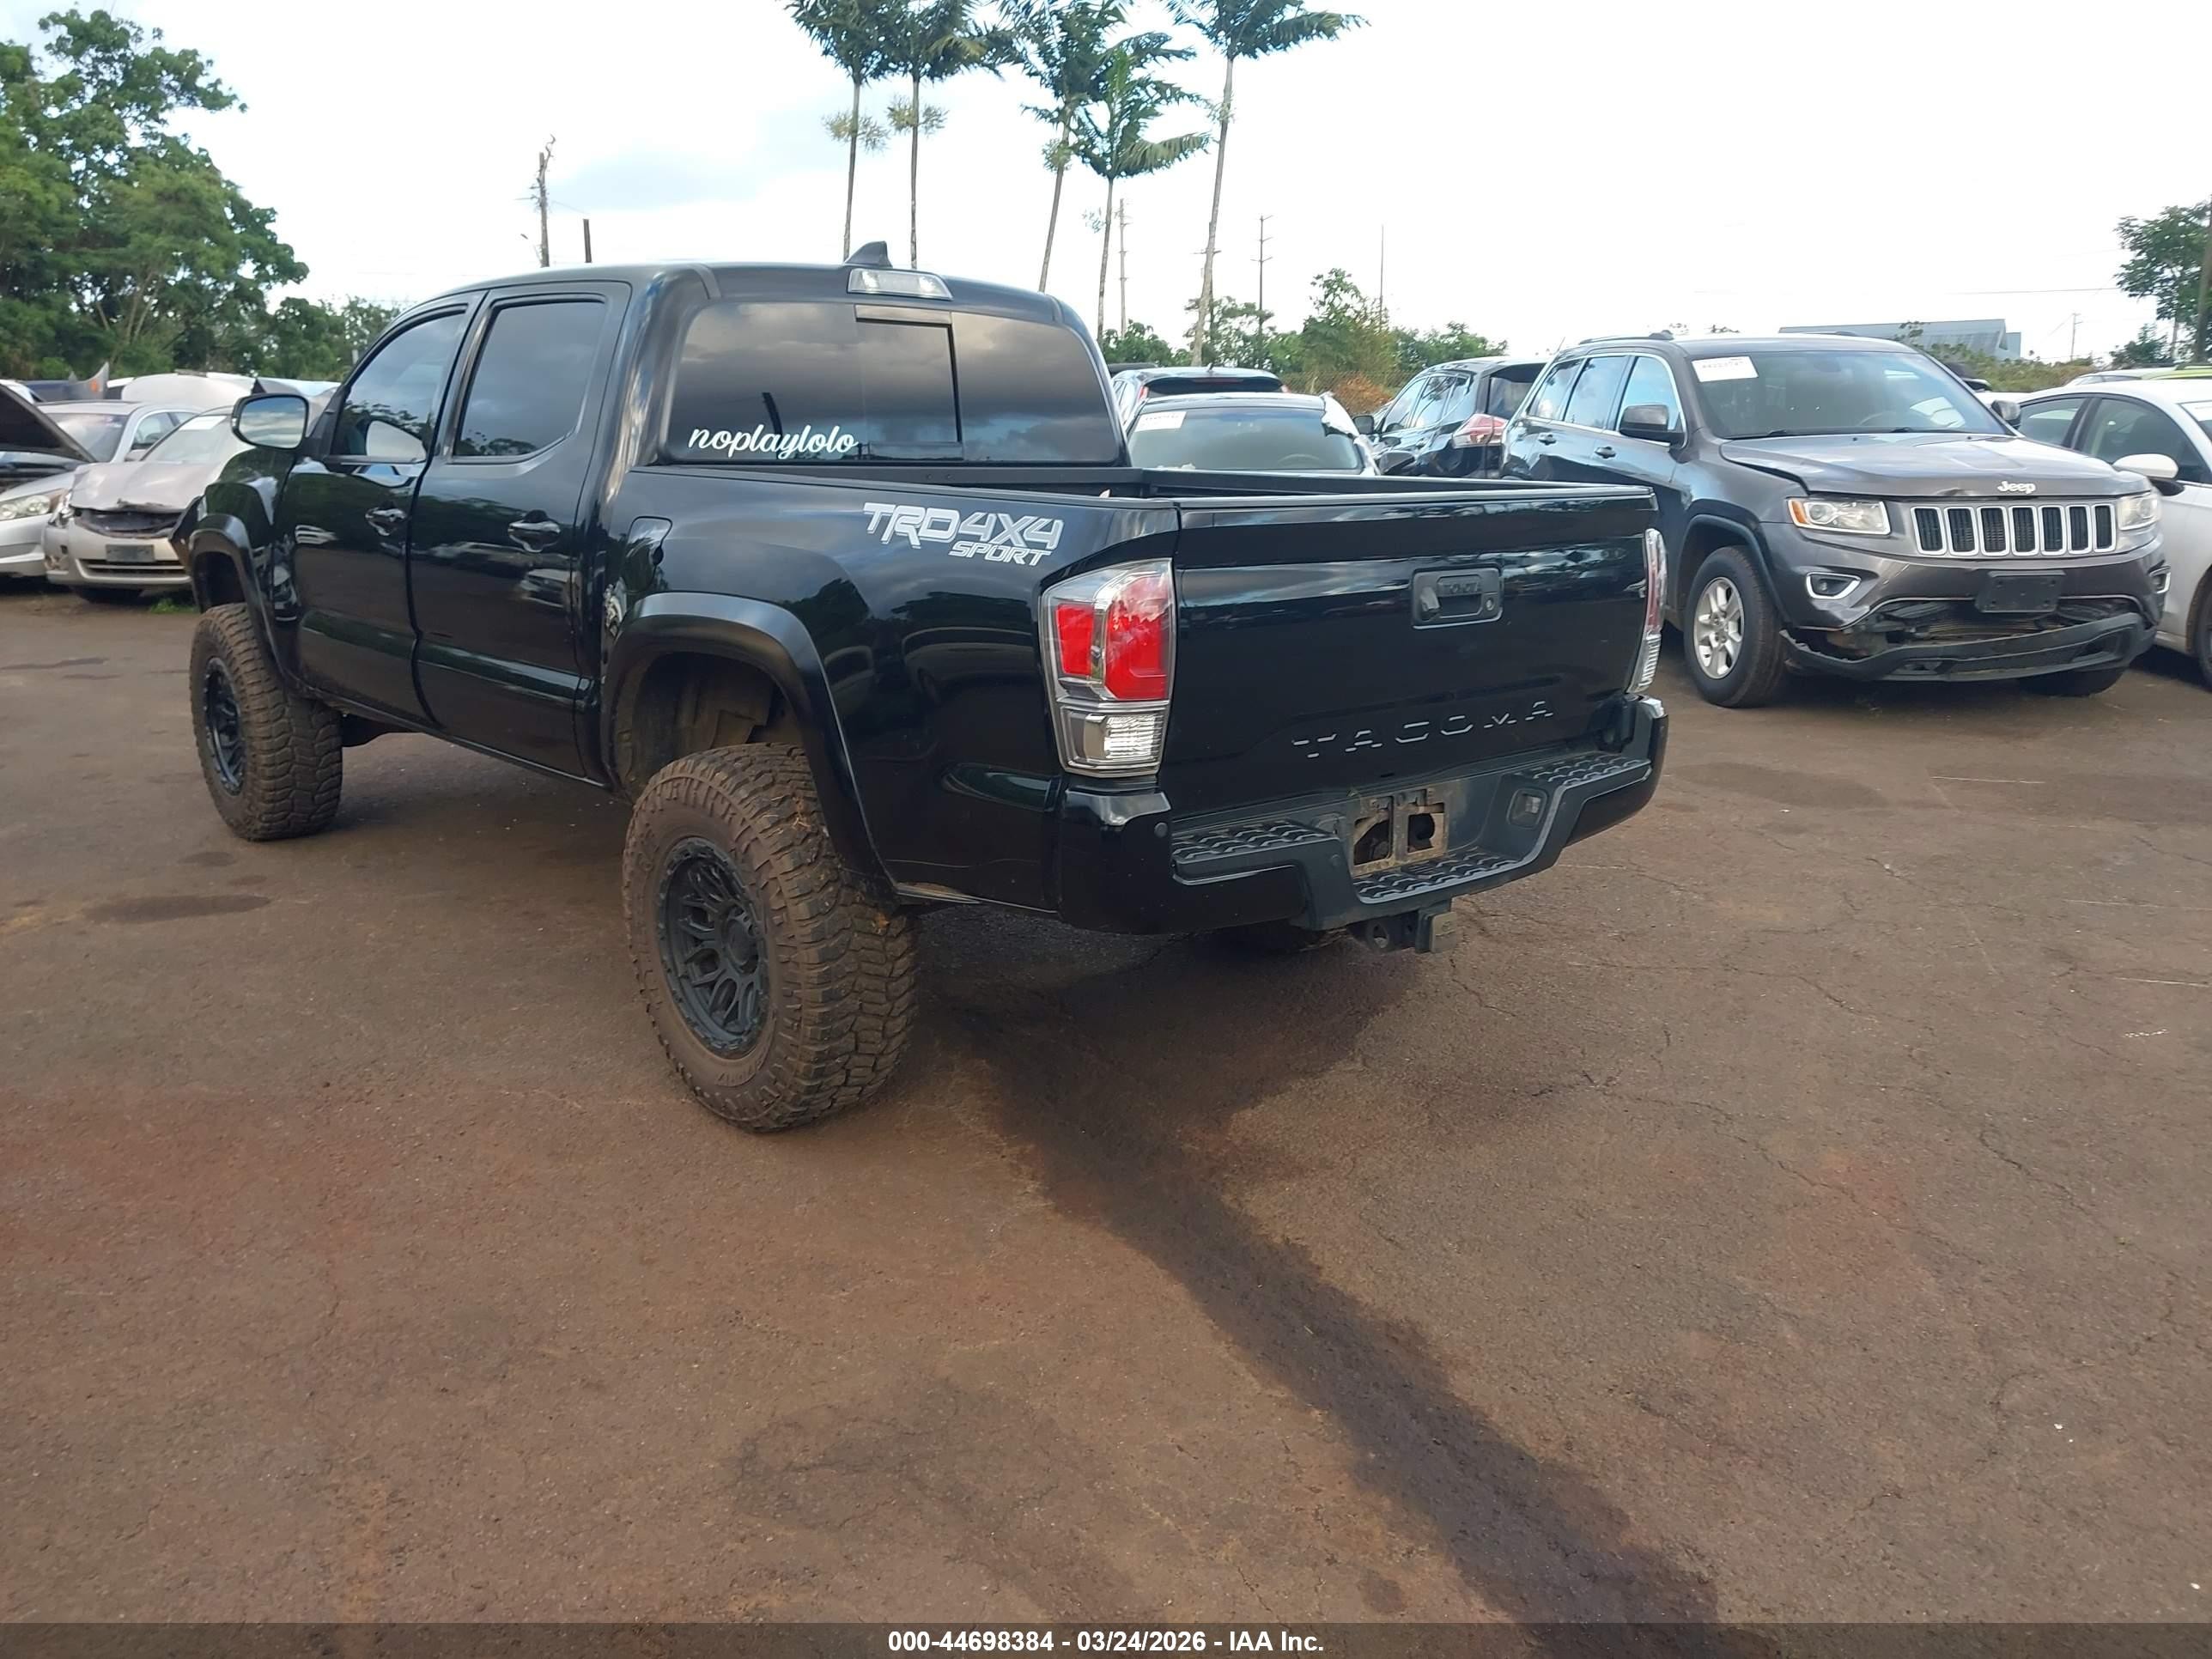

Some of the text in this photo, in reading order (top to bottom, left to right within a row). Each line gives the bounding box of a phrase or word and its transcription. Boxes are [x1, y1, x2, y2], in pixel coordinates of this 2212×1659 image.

[688, 423, 859, 459] noplaylolo
[1996, 480, 2036, 495] Jeep
[863, 501, 961, 549] TRD
[948, 540, 1052, 567] SPORT
[1291, 701, 1553, 757] TACOMA
